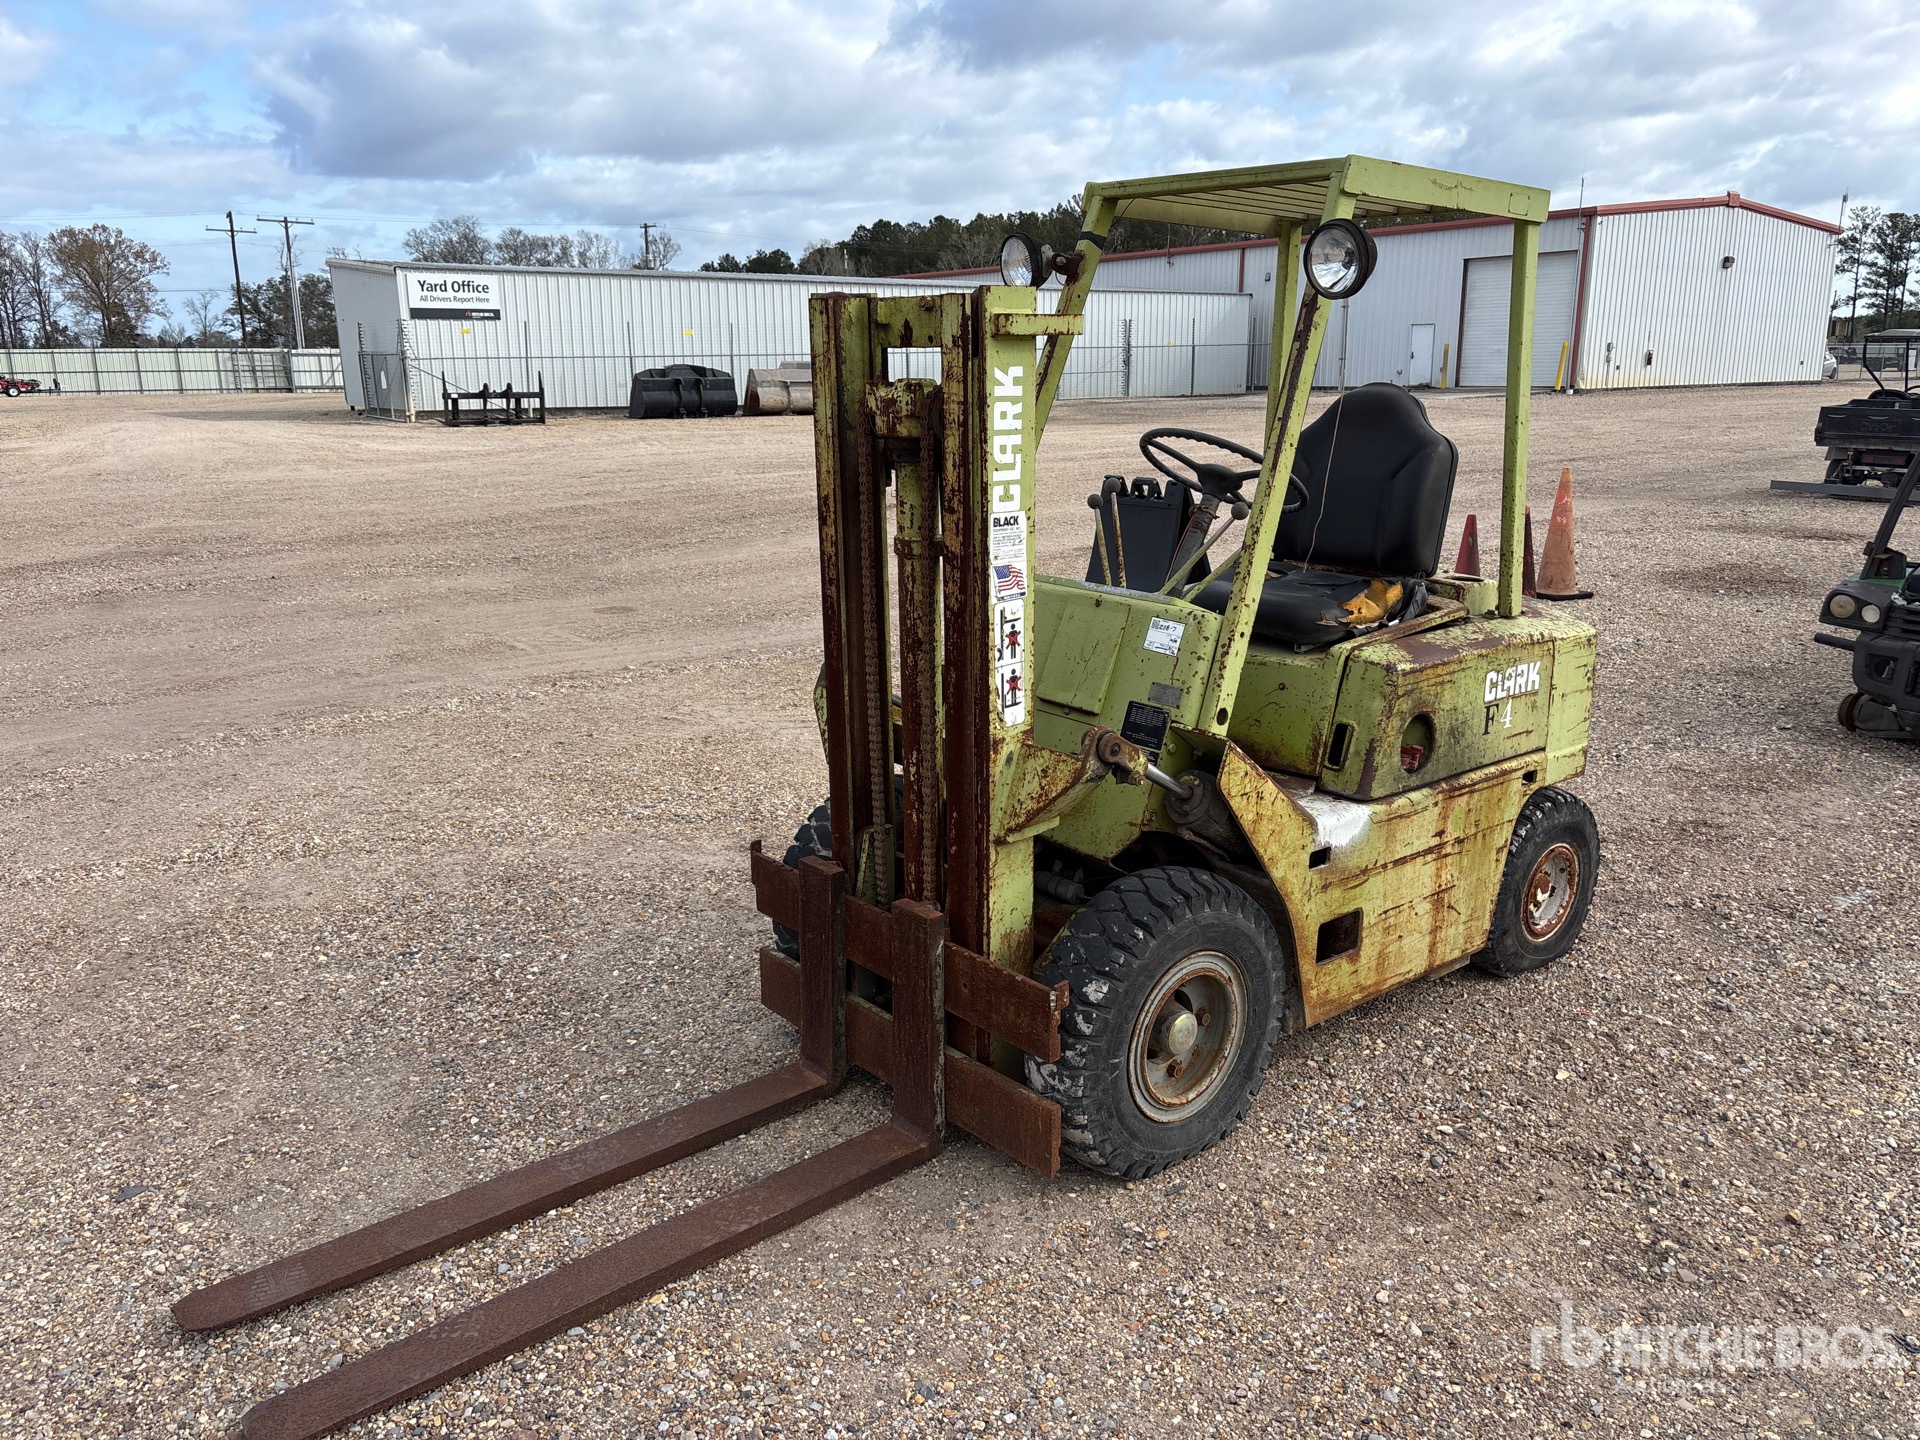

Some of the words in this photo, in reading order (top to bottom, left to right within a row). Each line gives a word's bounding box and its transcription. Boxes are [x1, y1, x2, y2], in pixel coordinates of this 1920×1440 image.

[417, 280, 448, 293] Yard
[451, 280, 489, 293] Office
[430, 295, 452, 303] Drivers
[453, 296, 474, 304] Report
[993, 366, 1023, 513] CLARK
[993, 515, 1019, 528] BLACK
[1484, 661, 1541, 703] CLARK
